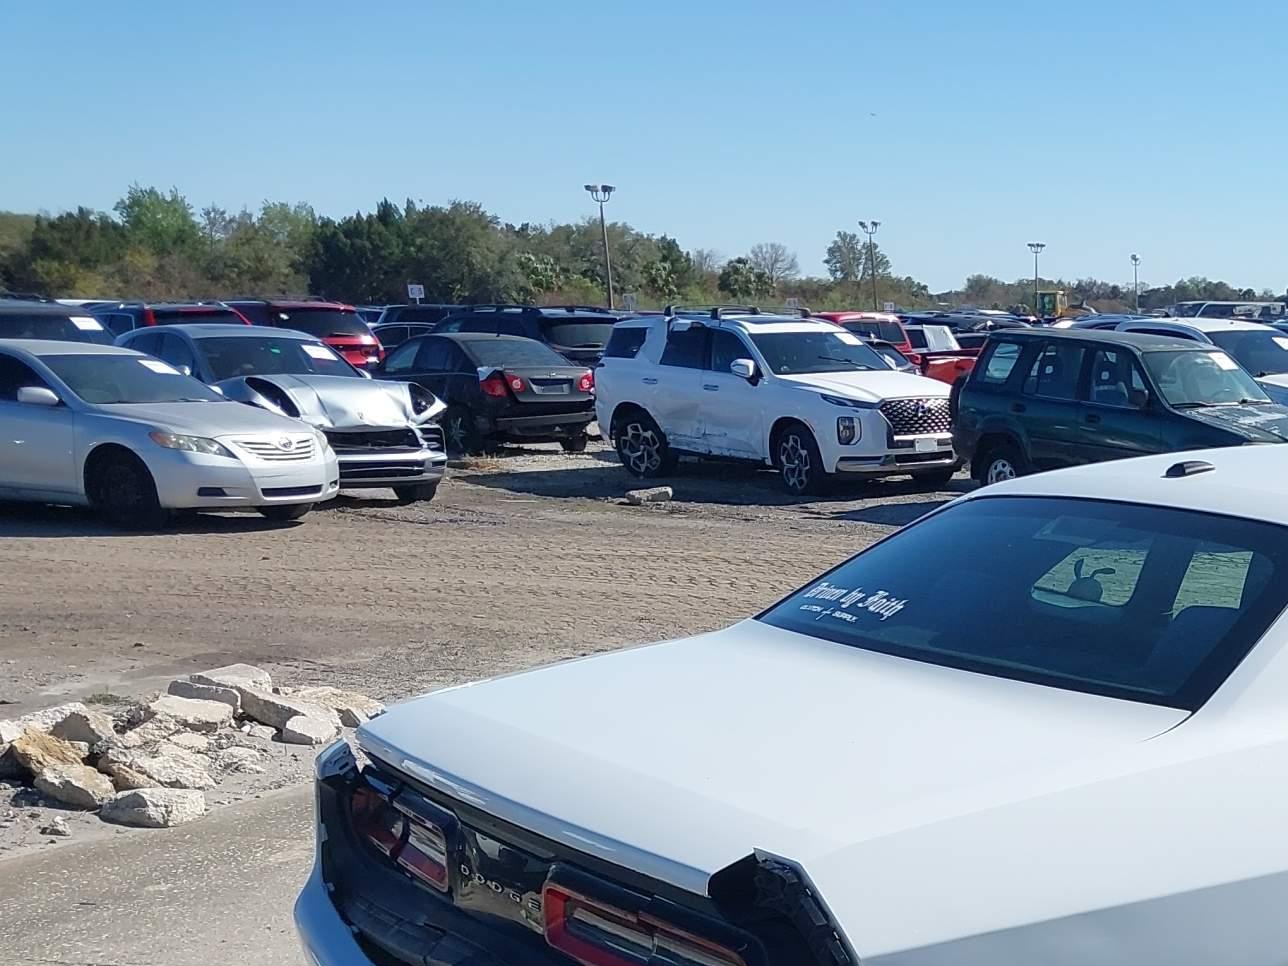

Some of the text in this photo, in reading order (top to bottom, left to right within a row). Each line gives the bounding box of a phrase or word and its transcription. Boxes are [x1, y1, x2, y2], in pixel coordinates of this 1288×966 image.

[839, 586, 866, 609] by
[857, 590, 909, 621] Faith
[460, 863, 541, 912] DODGE
